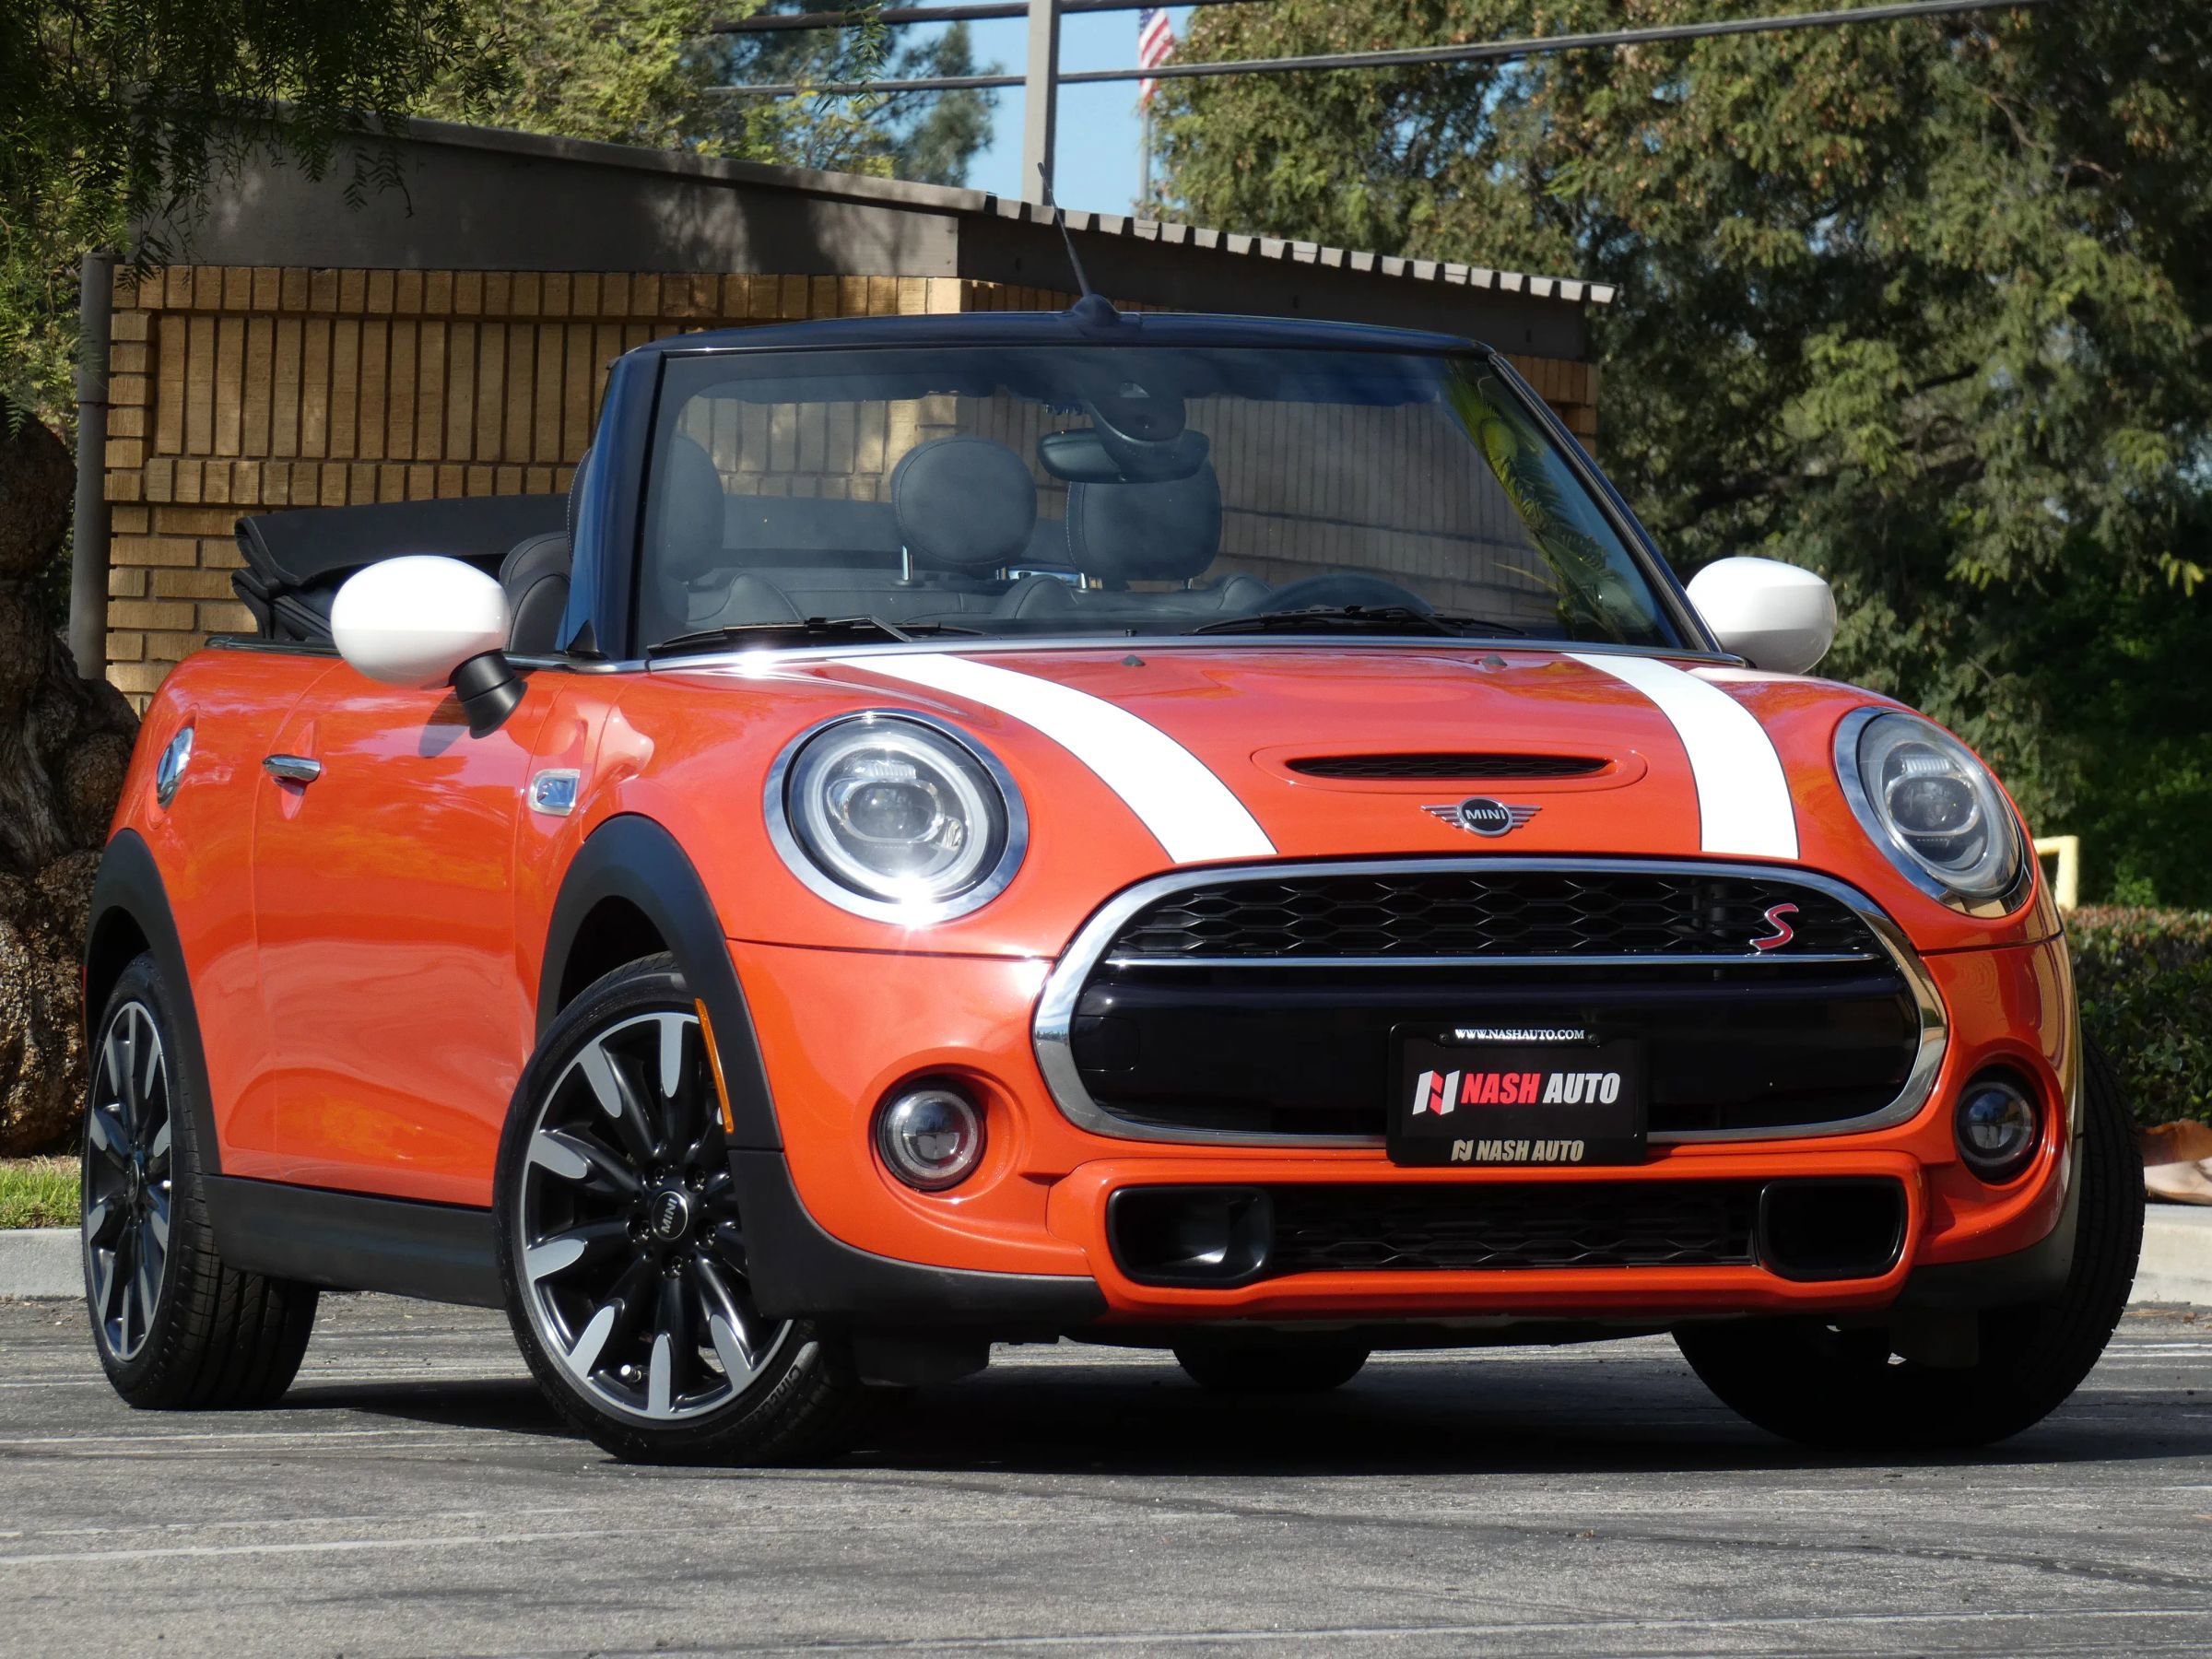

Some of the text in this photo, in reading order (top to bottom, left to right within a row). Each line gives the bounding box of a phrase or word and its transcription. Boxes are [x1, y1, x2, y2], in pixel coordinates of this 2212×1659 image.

[1465, 809, 1506, 820] MINI
[1749, 903, 1799, 950] S
[1454, 1029, 1585, 1041] WWW.NASHAUTO.COM
[1461, 1073, 1541, 1104] NASH
[1542, 1073, 1621, 1104] AUTO
[1476, 1140, 1532, 1161] NASH
[1534, 1140, 1585, 1161] AUTO
[661, 1198, 678, 1233] MINI
